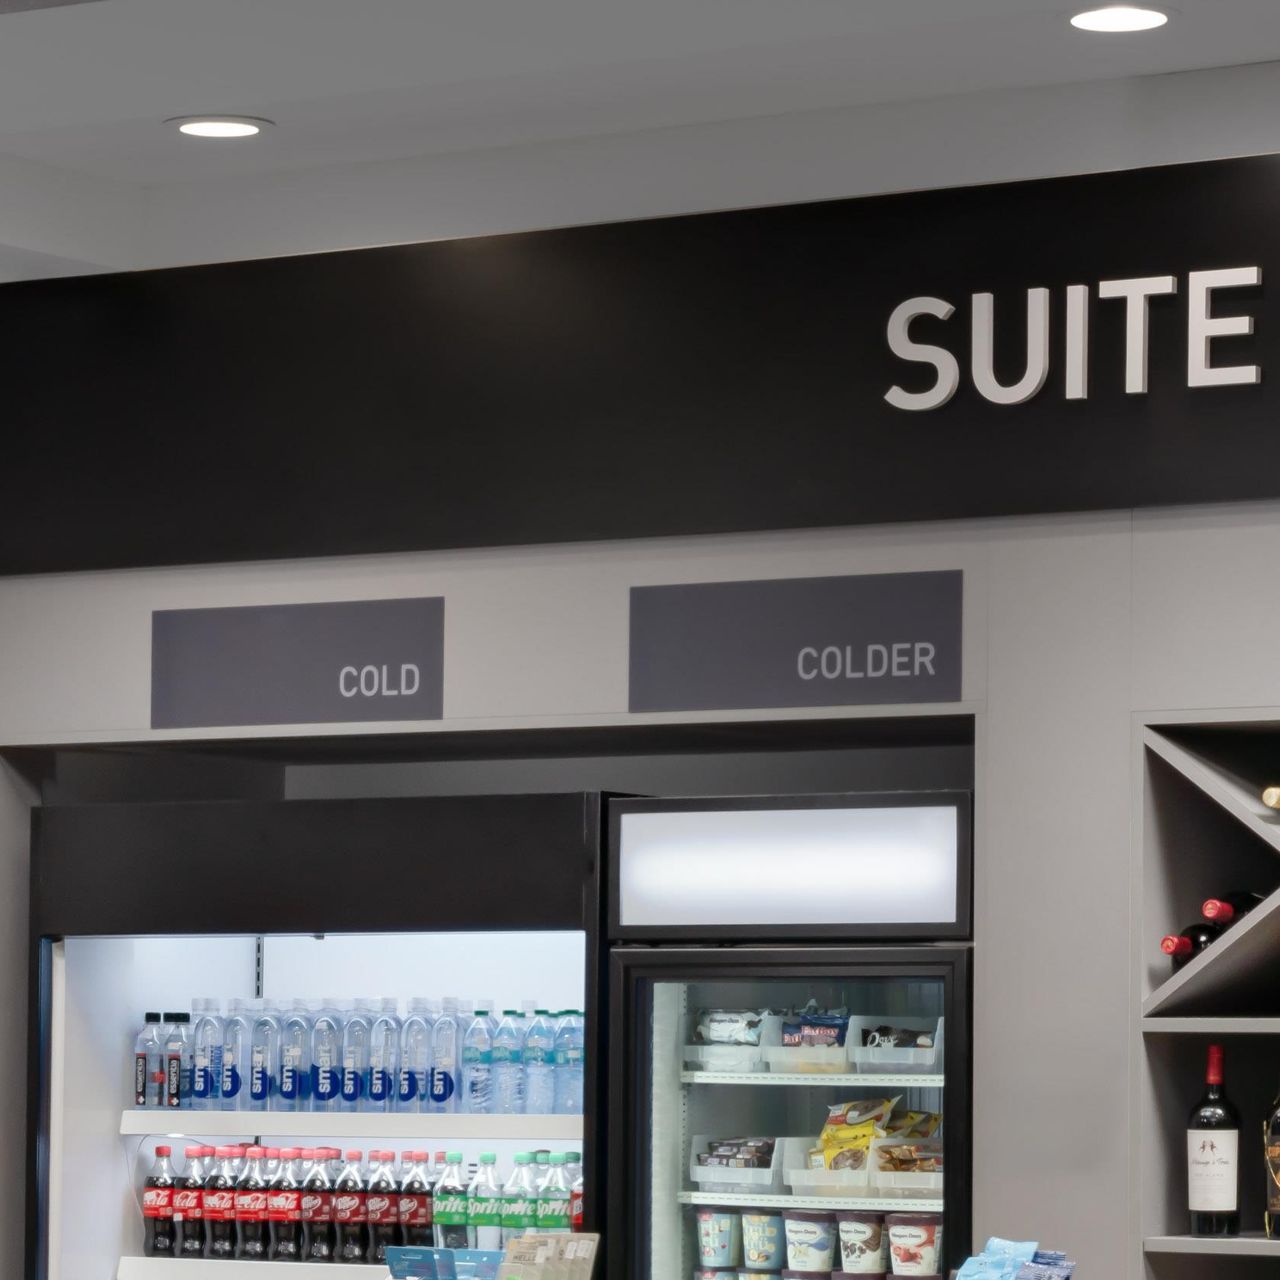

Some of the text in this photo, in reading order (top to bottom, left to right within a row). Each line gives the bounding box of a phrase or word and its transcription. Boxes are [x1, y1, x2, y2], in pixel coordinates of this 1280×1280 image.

[883, 266, 1262, 411] SUITE
[797, 642, 937, 681] COLDER
[338, 663, 421, 698] COLD
[512, 1254, 536, 1262] MIELL
